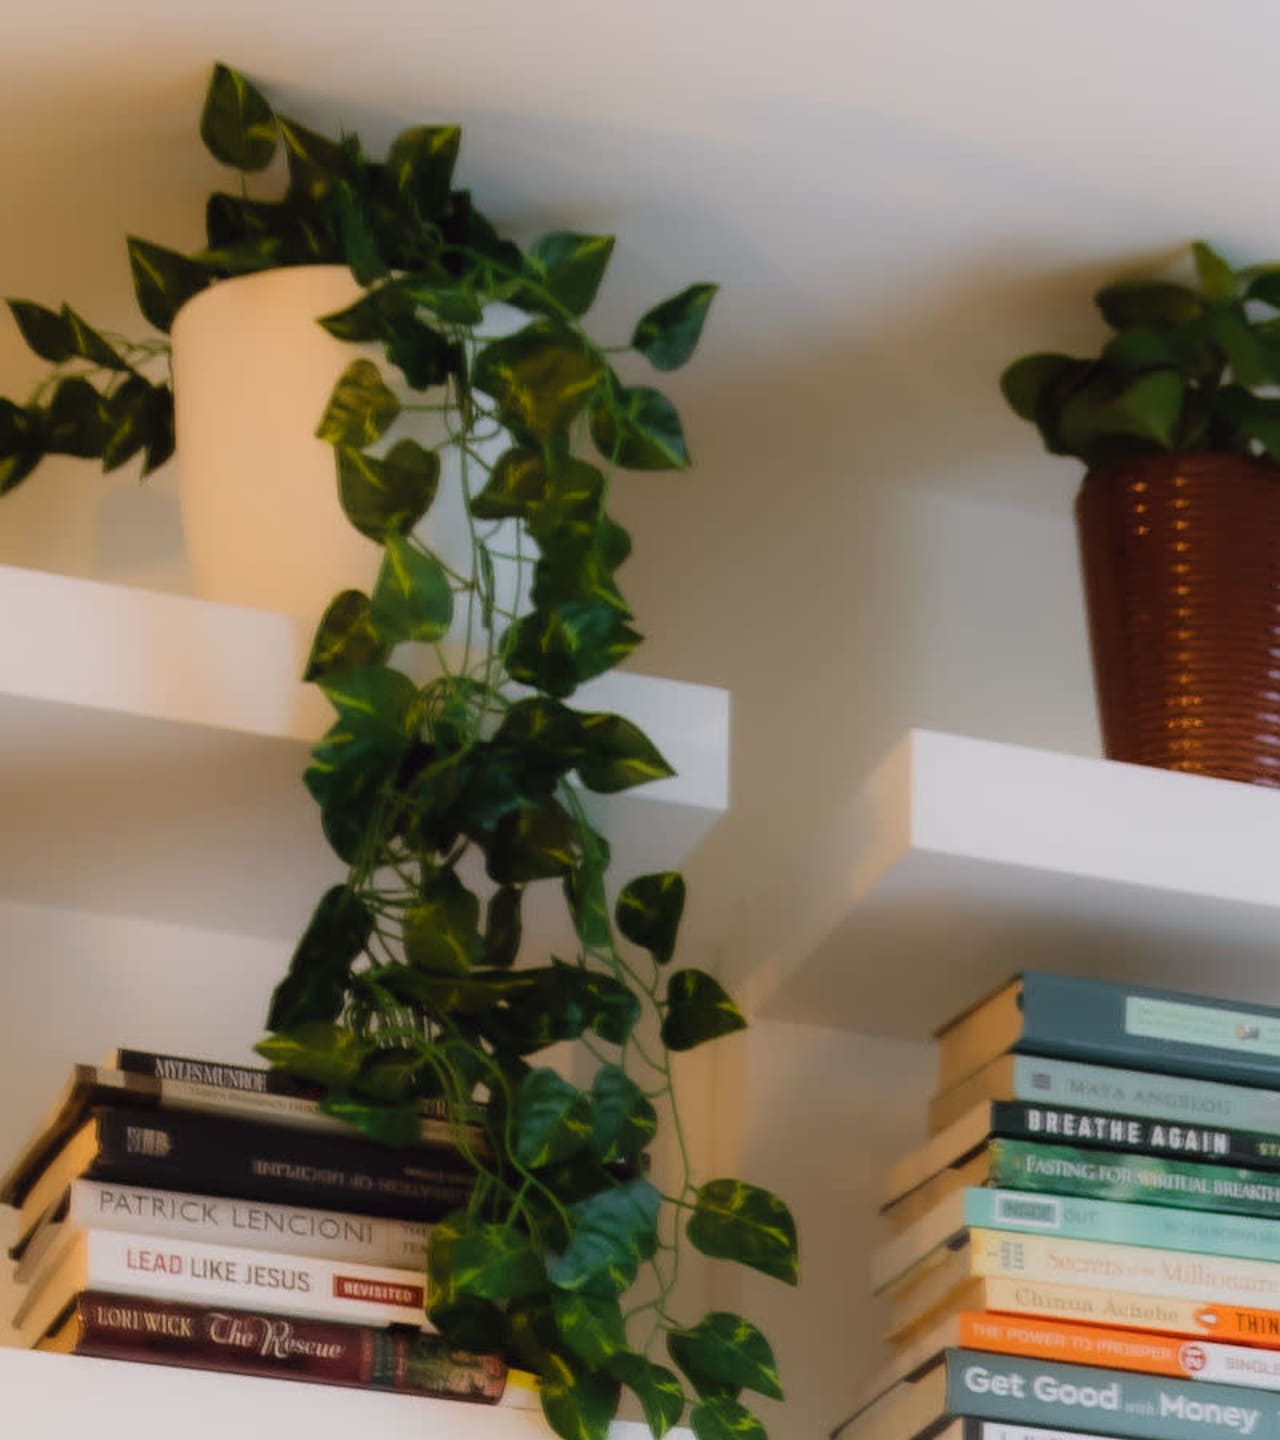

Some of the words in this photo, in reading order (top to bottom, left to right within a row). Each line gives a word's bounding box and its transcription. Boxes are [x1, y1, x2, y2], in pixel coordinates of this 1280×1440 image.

[1026, 1109, 1142, 1144] BREATHE
[1150, 1124, 1231, 1154] AGAIN
[1025, 1155, 1097, 1179] FASTING
[1099, 1165, 1132, 1183] FOR
[1136, 1169, 1210, 1194] SPIRITUAL
[99, 1190, 219, 1226] PATRICK
[231, 1204, 374, 1244] LENCIONI
[126, 1249, 182, 1275] LEAD
[190, 1257, 237, 1283] LIKE
[244, 1265, 311, 1292] JESUS
[343, 1281, 414, 1302] REVISITED
[97, 1306, 141, 1331] LORI
[143, 1312, 192, 1337] WICK
[1015, 1288, 1093, 1312] Chinua
[1103, 1300, 1180, 1323] Achebe
[205, 1313, 252, 1347] The
[254, 1318, 345, 1359] Rescue
[963, 1366, 1025, 1399] Get
[1033, 1375, 1122, 1411] Good
[1159, 1392, 1262, 1435] Money
